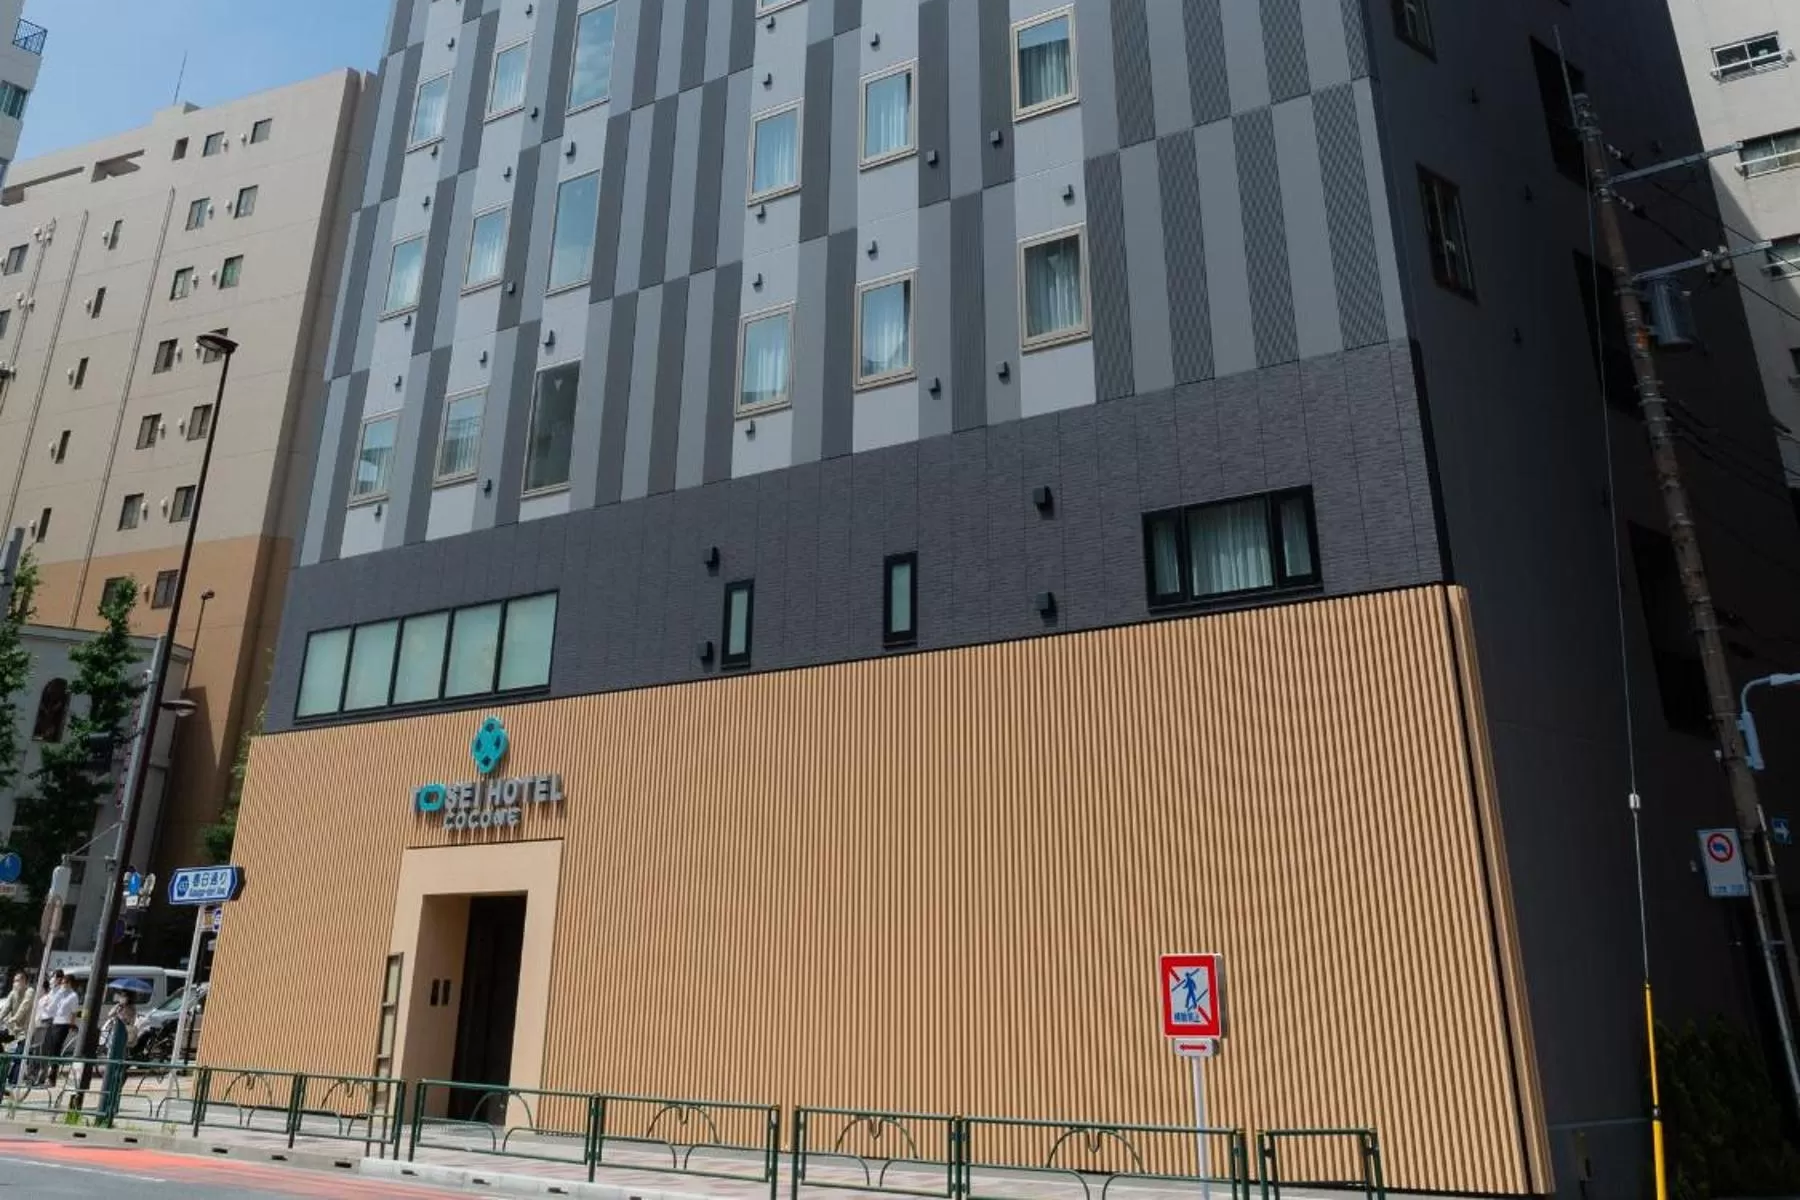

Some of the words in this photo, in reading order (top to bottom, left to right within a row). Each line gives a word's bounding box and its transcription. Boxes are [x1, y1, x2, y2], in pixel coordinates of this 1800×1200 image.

[409, 781, 481, 815] TOSEI
[487, 773, 564, 805] HOTEL
[443, 808, 522, 830] COCONE
